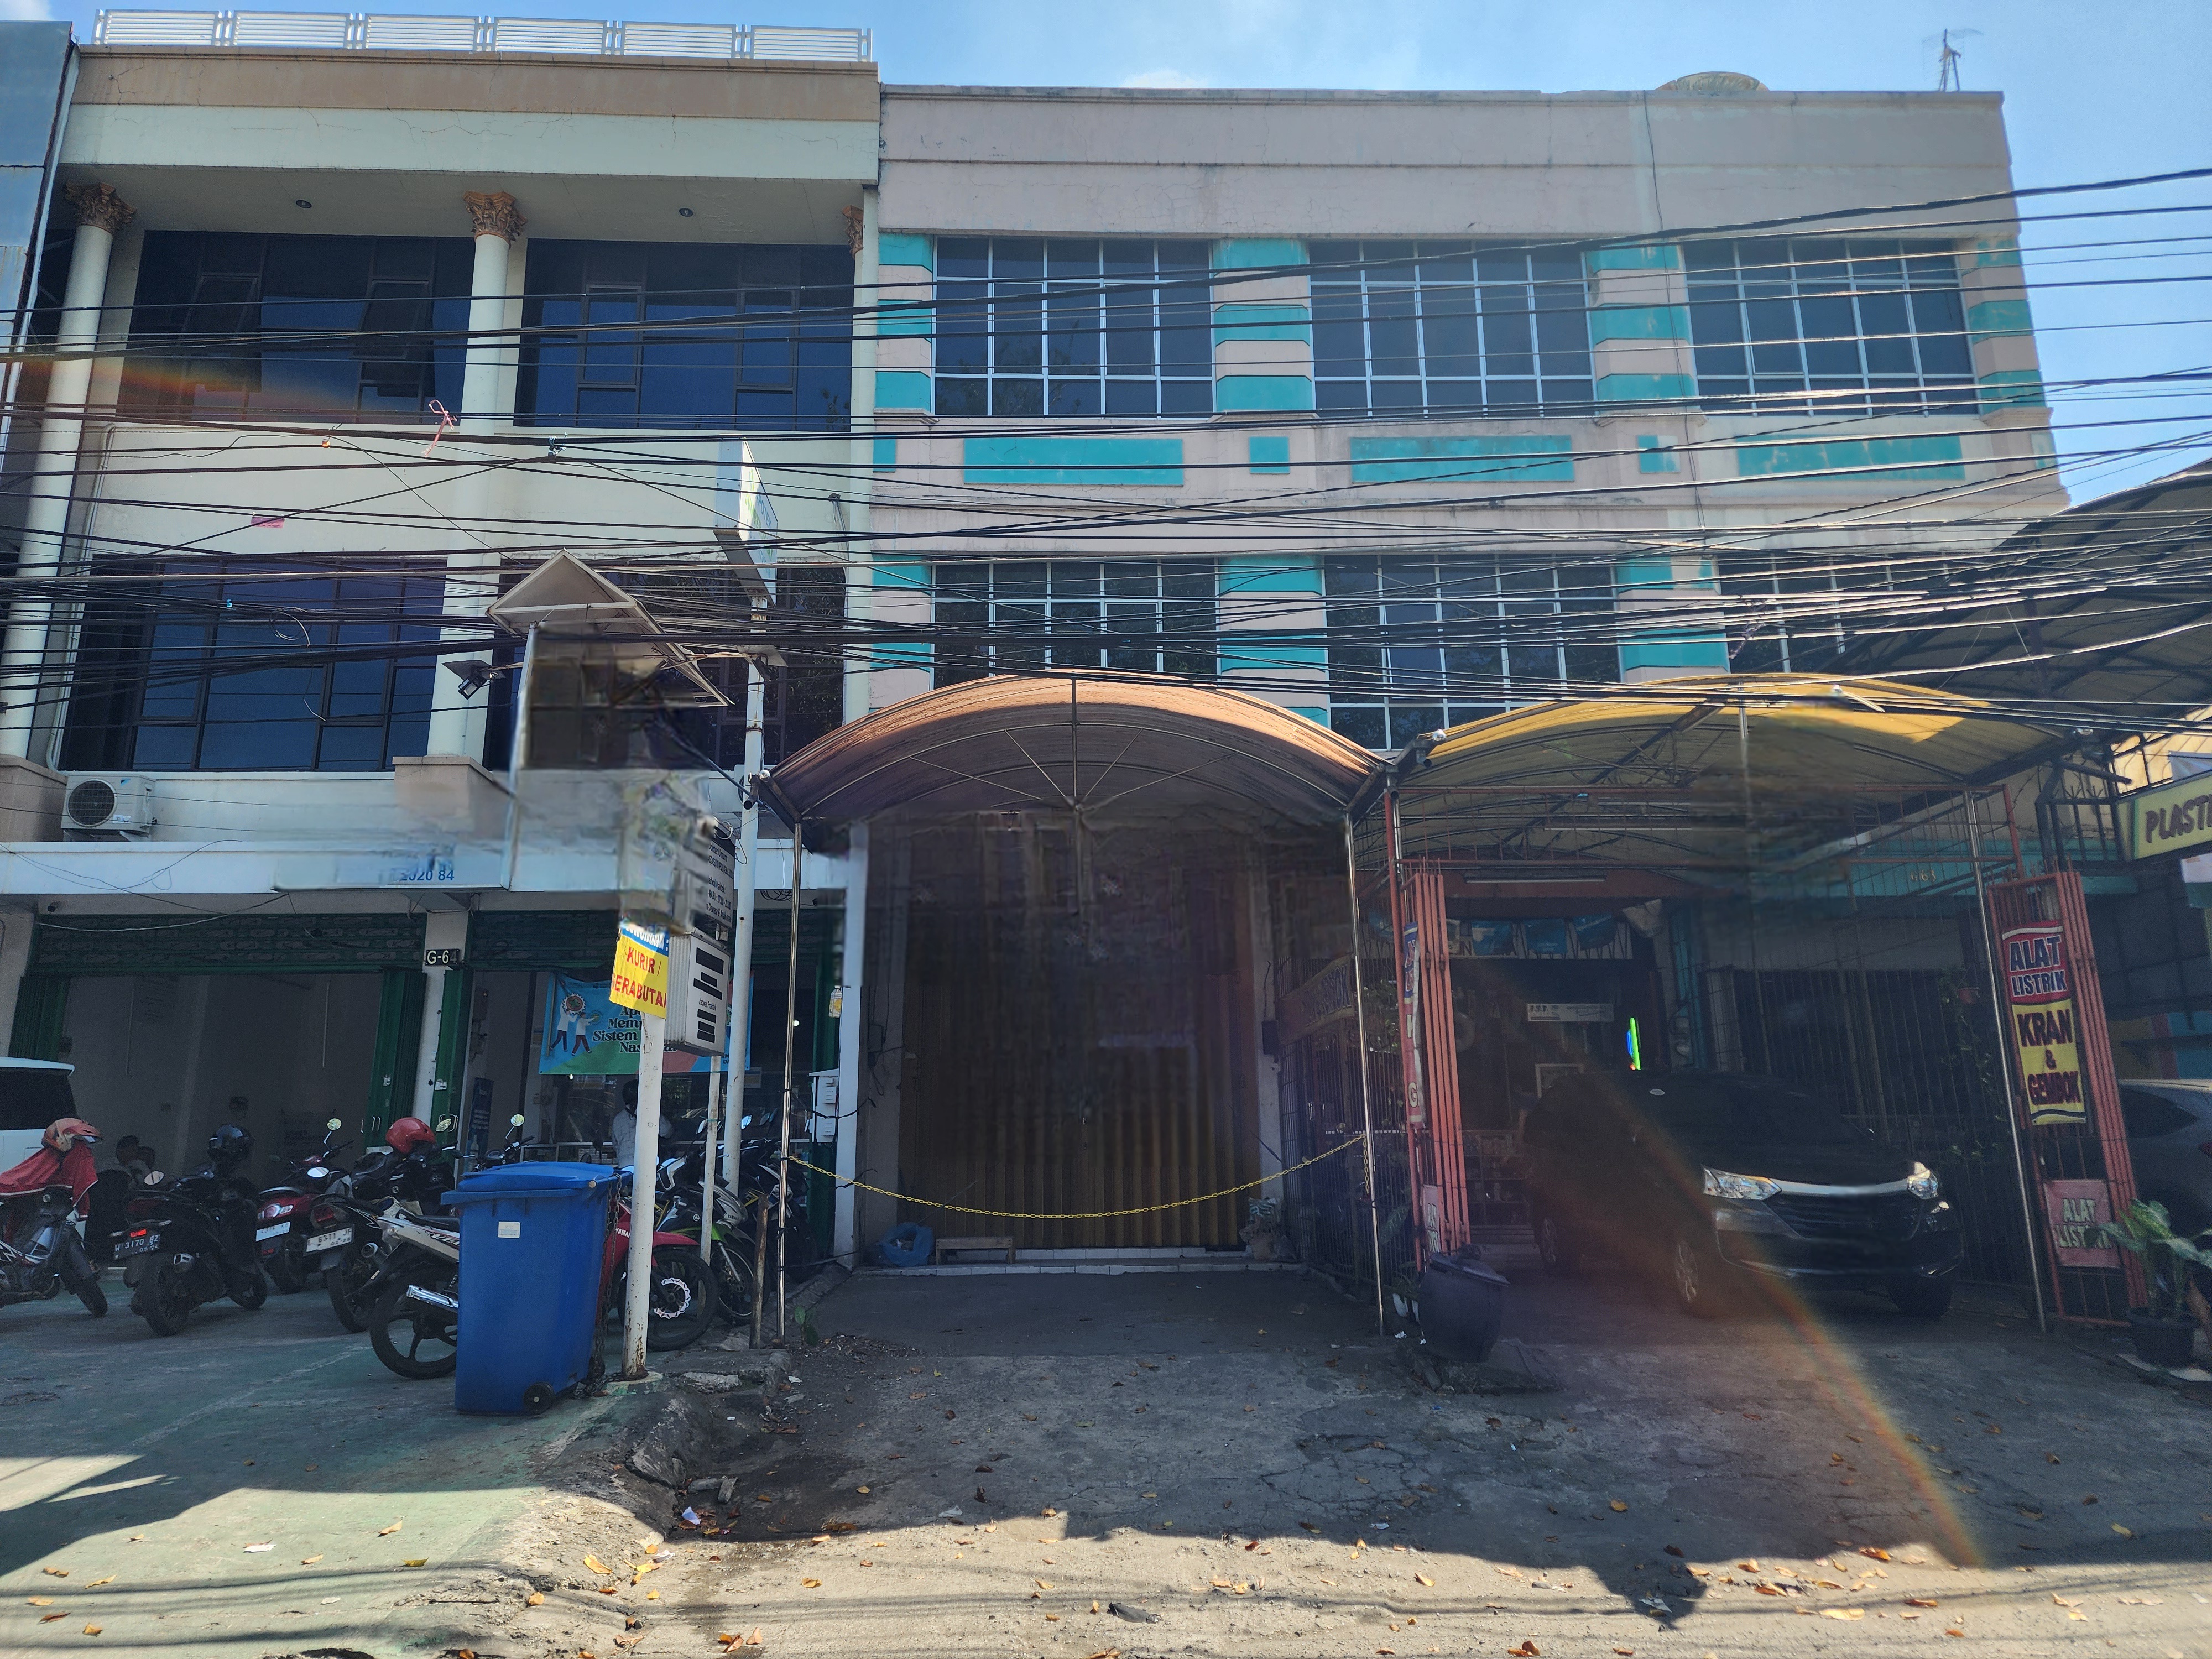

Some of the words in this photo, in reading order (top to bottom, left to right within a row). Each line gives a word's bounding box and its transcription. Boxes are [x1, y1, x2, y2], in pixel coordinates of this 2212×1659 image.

[438, 870, 455, 881] 84
[627, 946, 655, 974] KURIR
[2009, 935, 2061, 972] ALAT
[2010, 970, 2068, 997] LISTRIK
[592, 1030, 638, 1041] Sistem
[2017, 1008, 2073, 1047] KRAN
[2046, 1049, 2057, 1070] &
[2028, 1071, 2081, 1105] GEMBOK
[2063, 1198, 2096, 1223] ALAT
